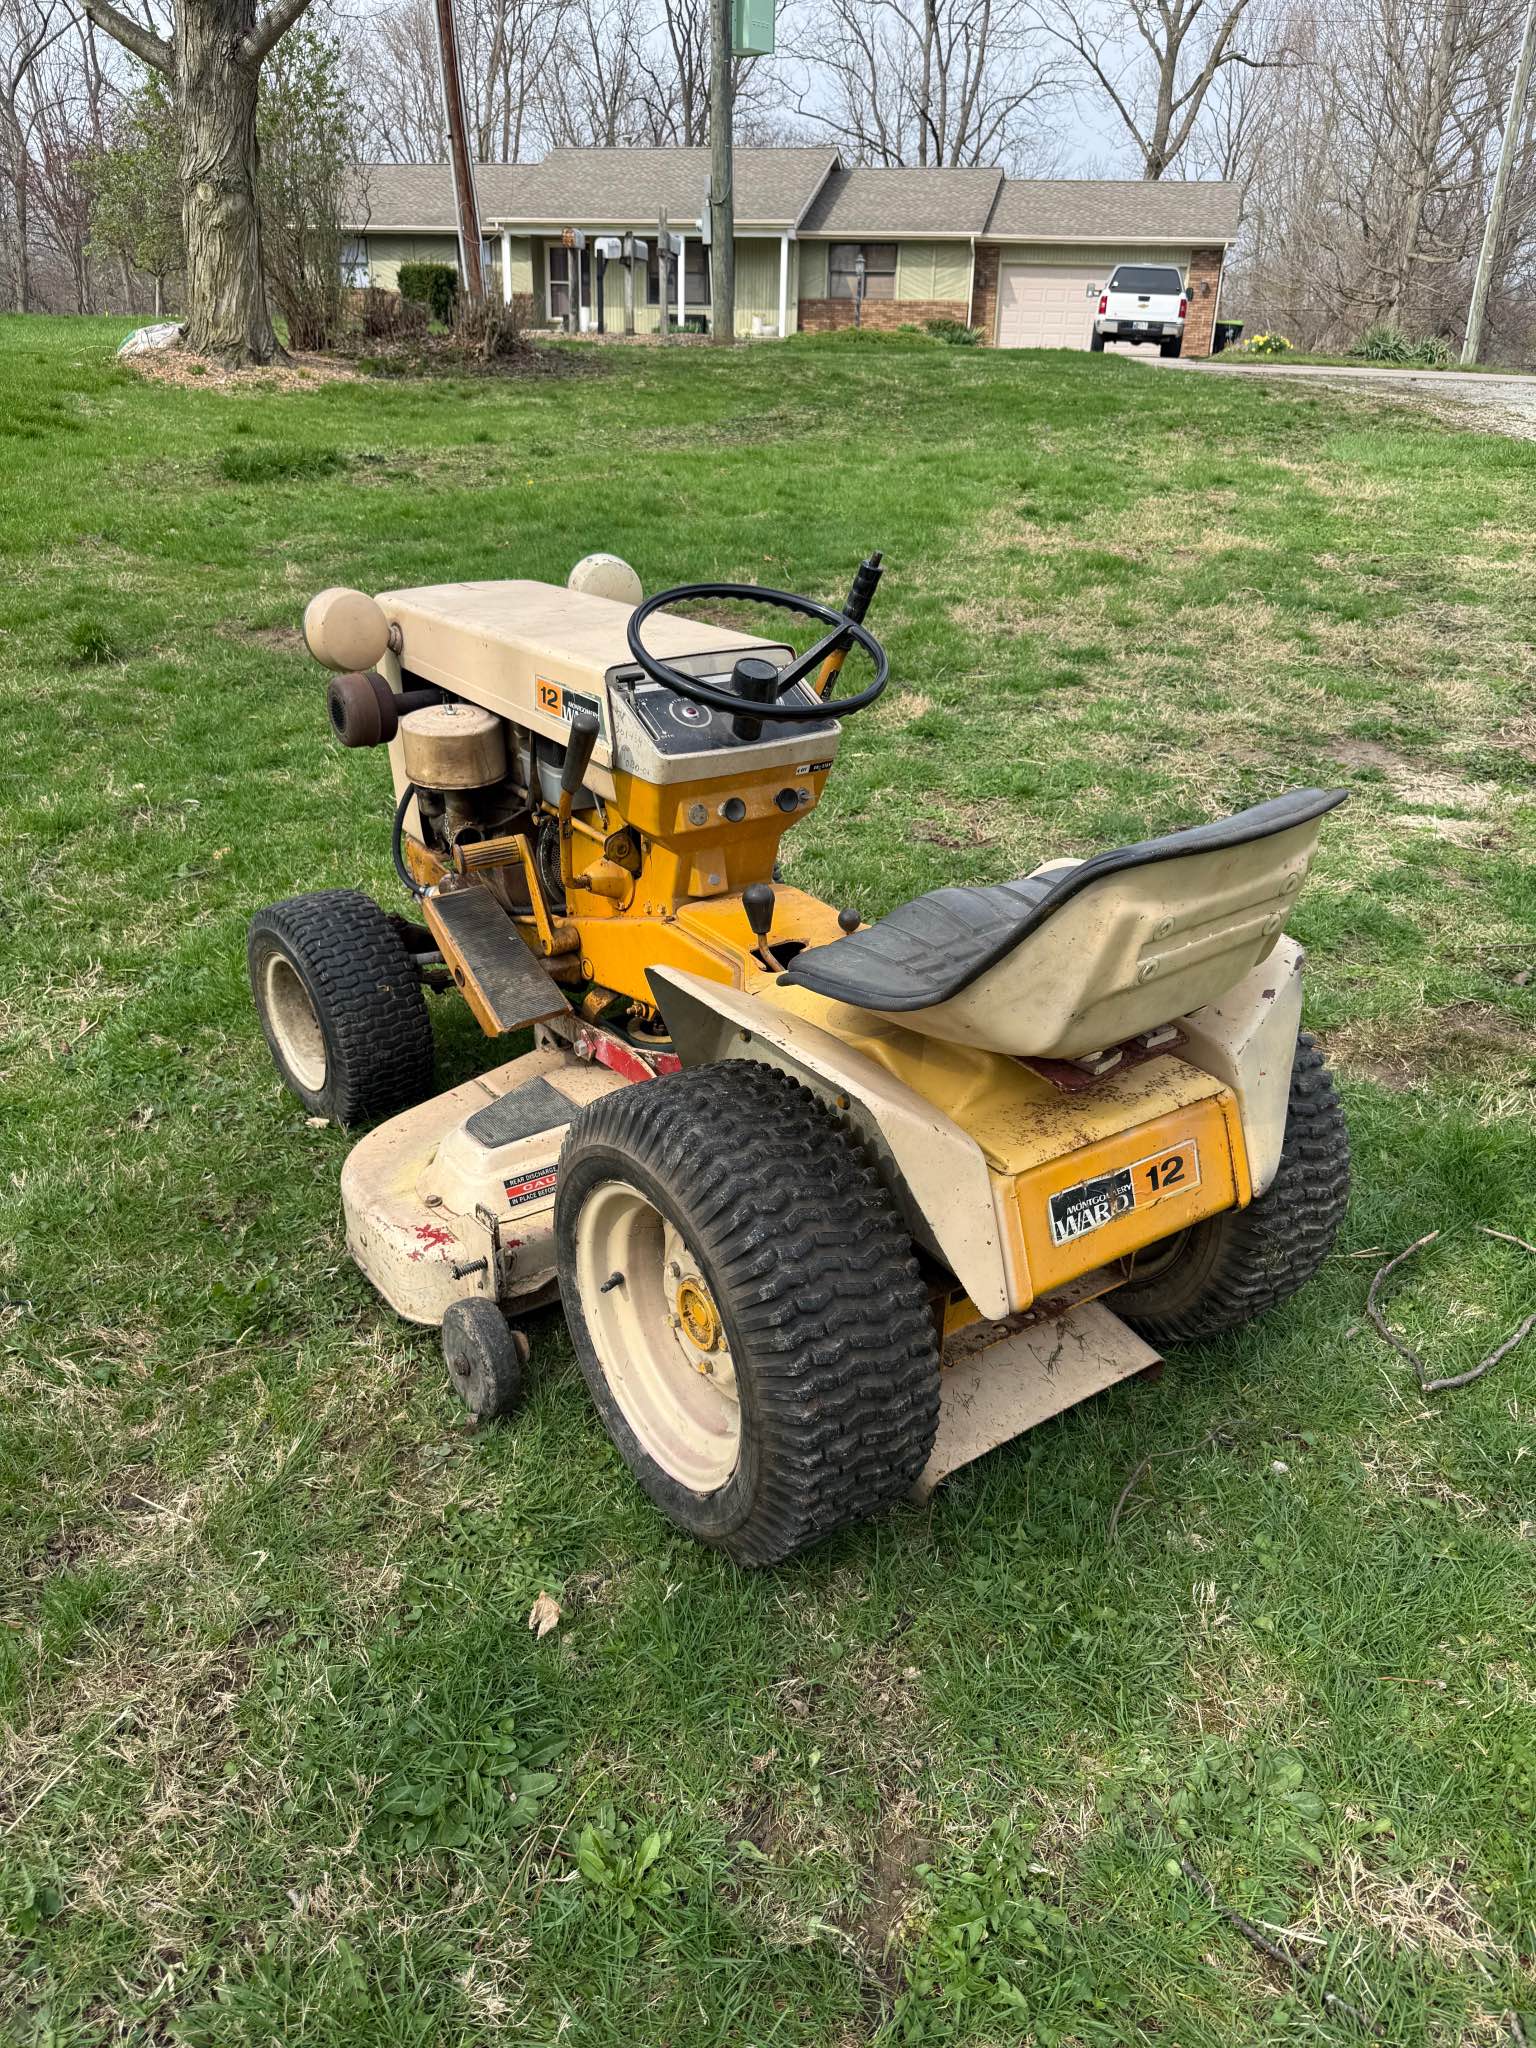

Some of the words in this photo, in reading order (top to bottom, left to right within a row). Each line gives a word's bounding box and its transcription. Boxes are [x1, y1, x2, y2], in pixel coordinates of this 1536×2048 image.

[541, 686, 558, 708] 12
[509, 1177, 525, 1186] REAR
[526, 1167, 557, 1181] DISCHARGE
[523, 1176, 556, 1191] CAU
[1146, 1156, 1185, 1192] 12
[519, 1192, 538, 1202] PLACE
[538, 1186, 557, 1196] BEFOR
